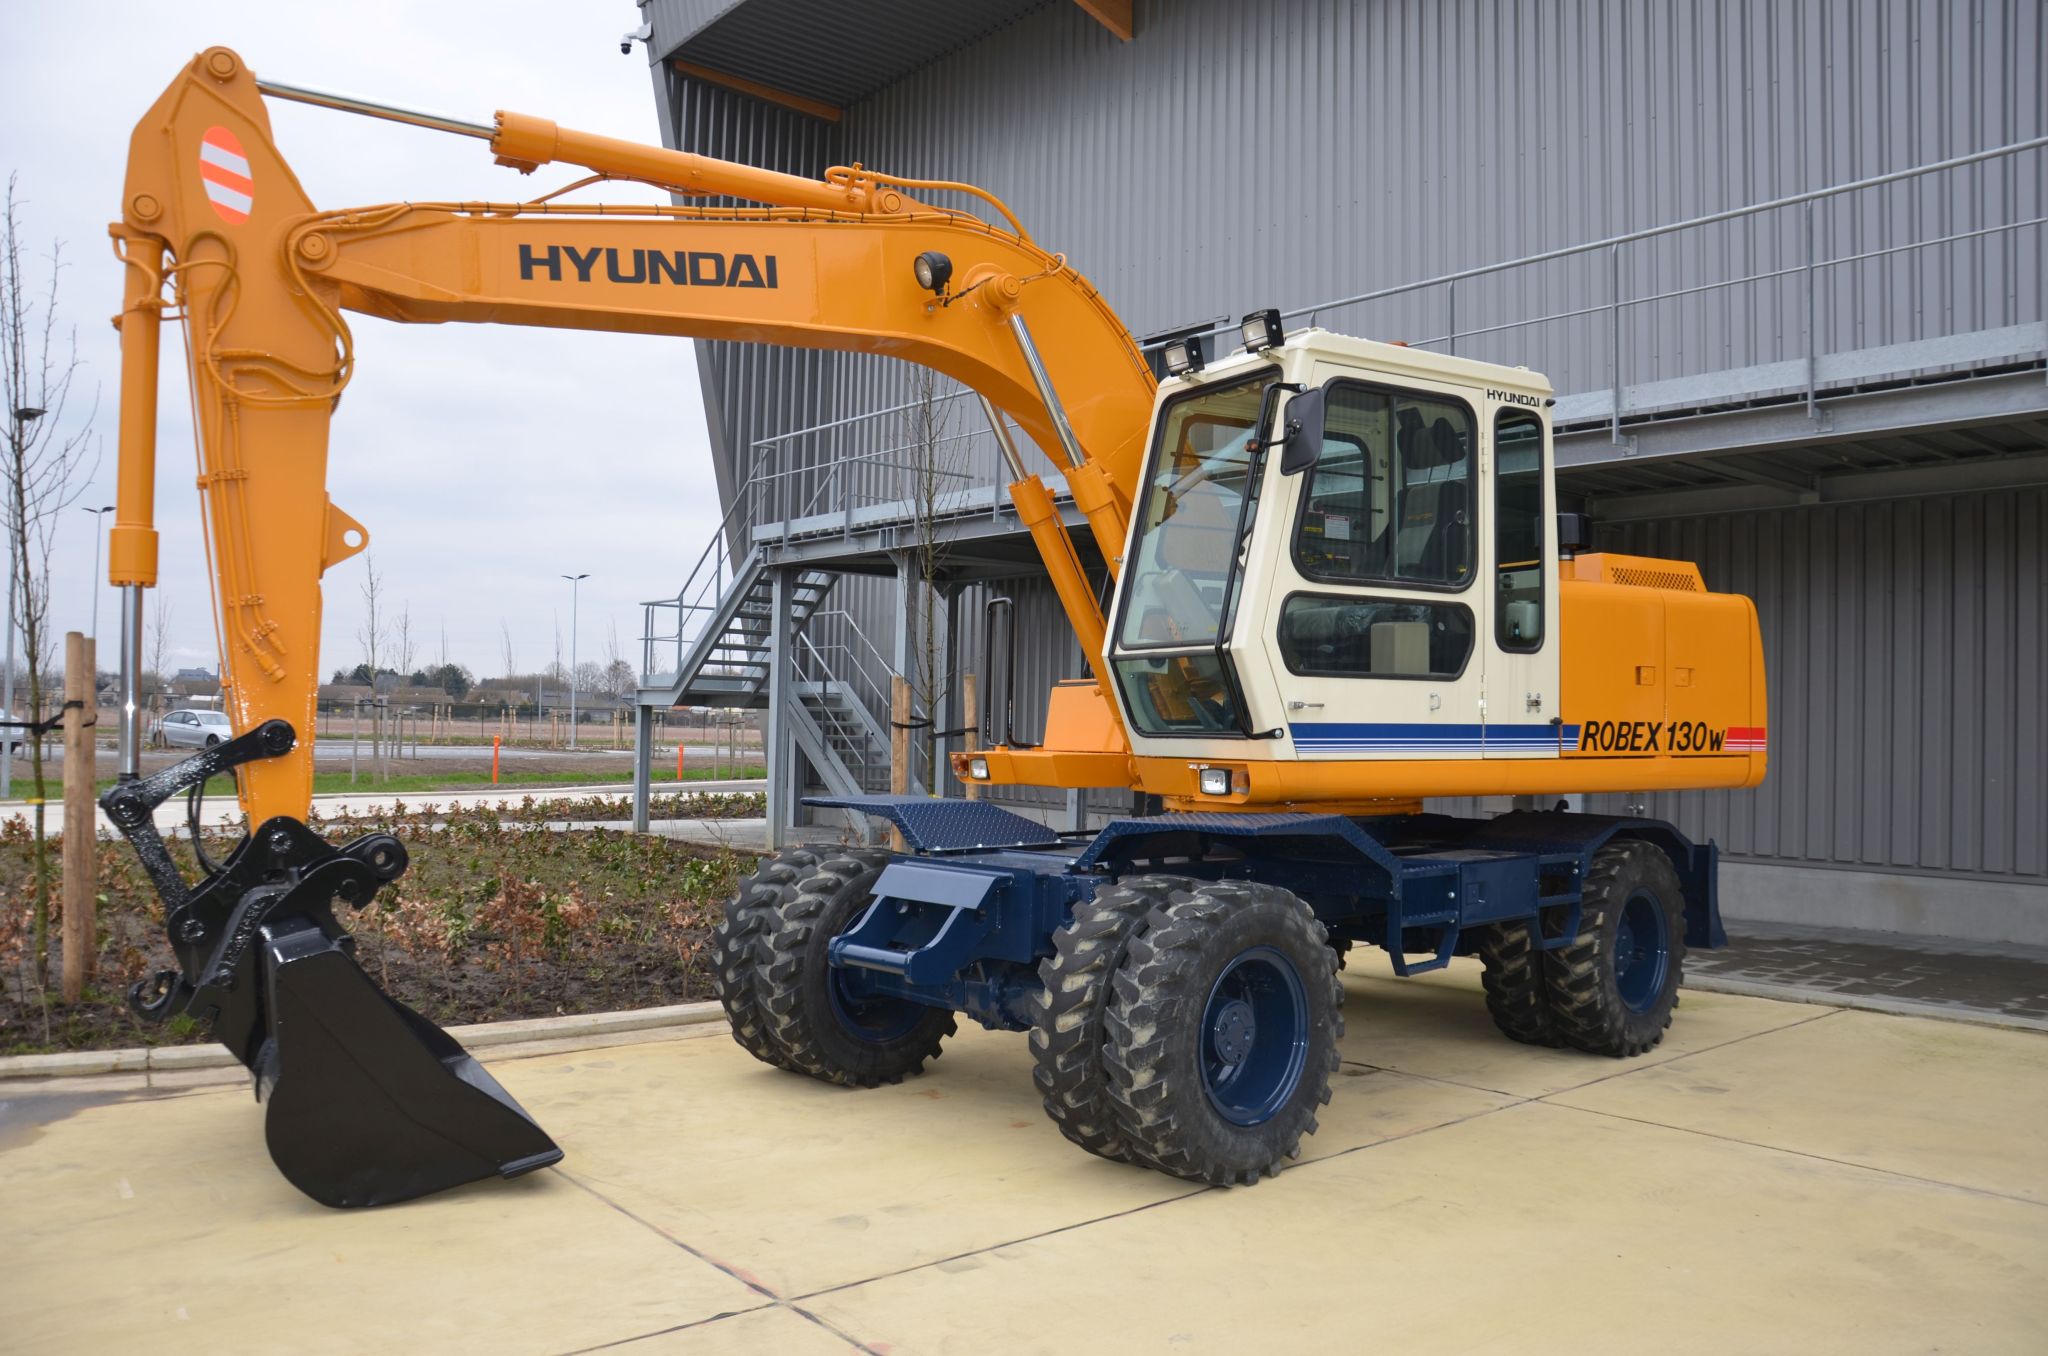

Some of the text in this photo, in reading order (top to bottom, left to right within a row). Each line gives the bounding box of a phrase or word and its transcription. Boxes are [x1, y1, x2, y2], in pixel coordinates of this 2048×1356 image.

[518, 244, 778, 289] HYUNDAI
[1486, 388, 1540, 408] HYUNDAI
[1581, 720, 1663, 751] ROBEX
